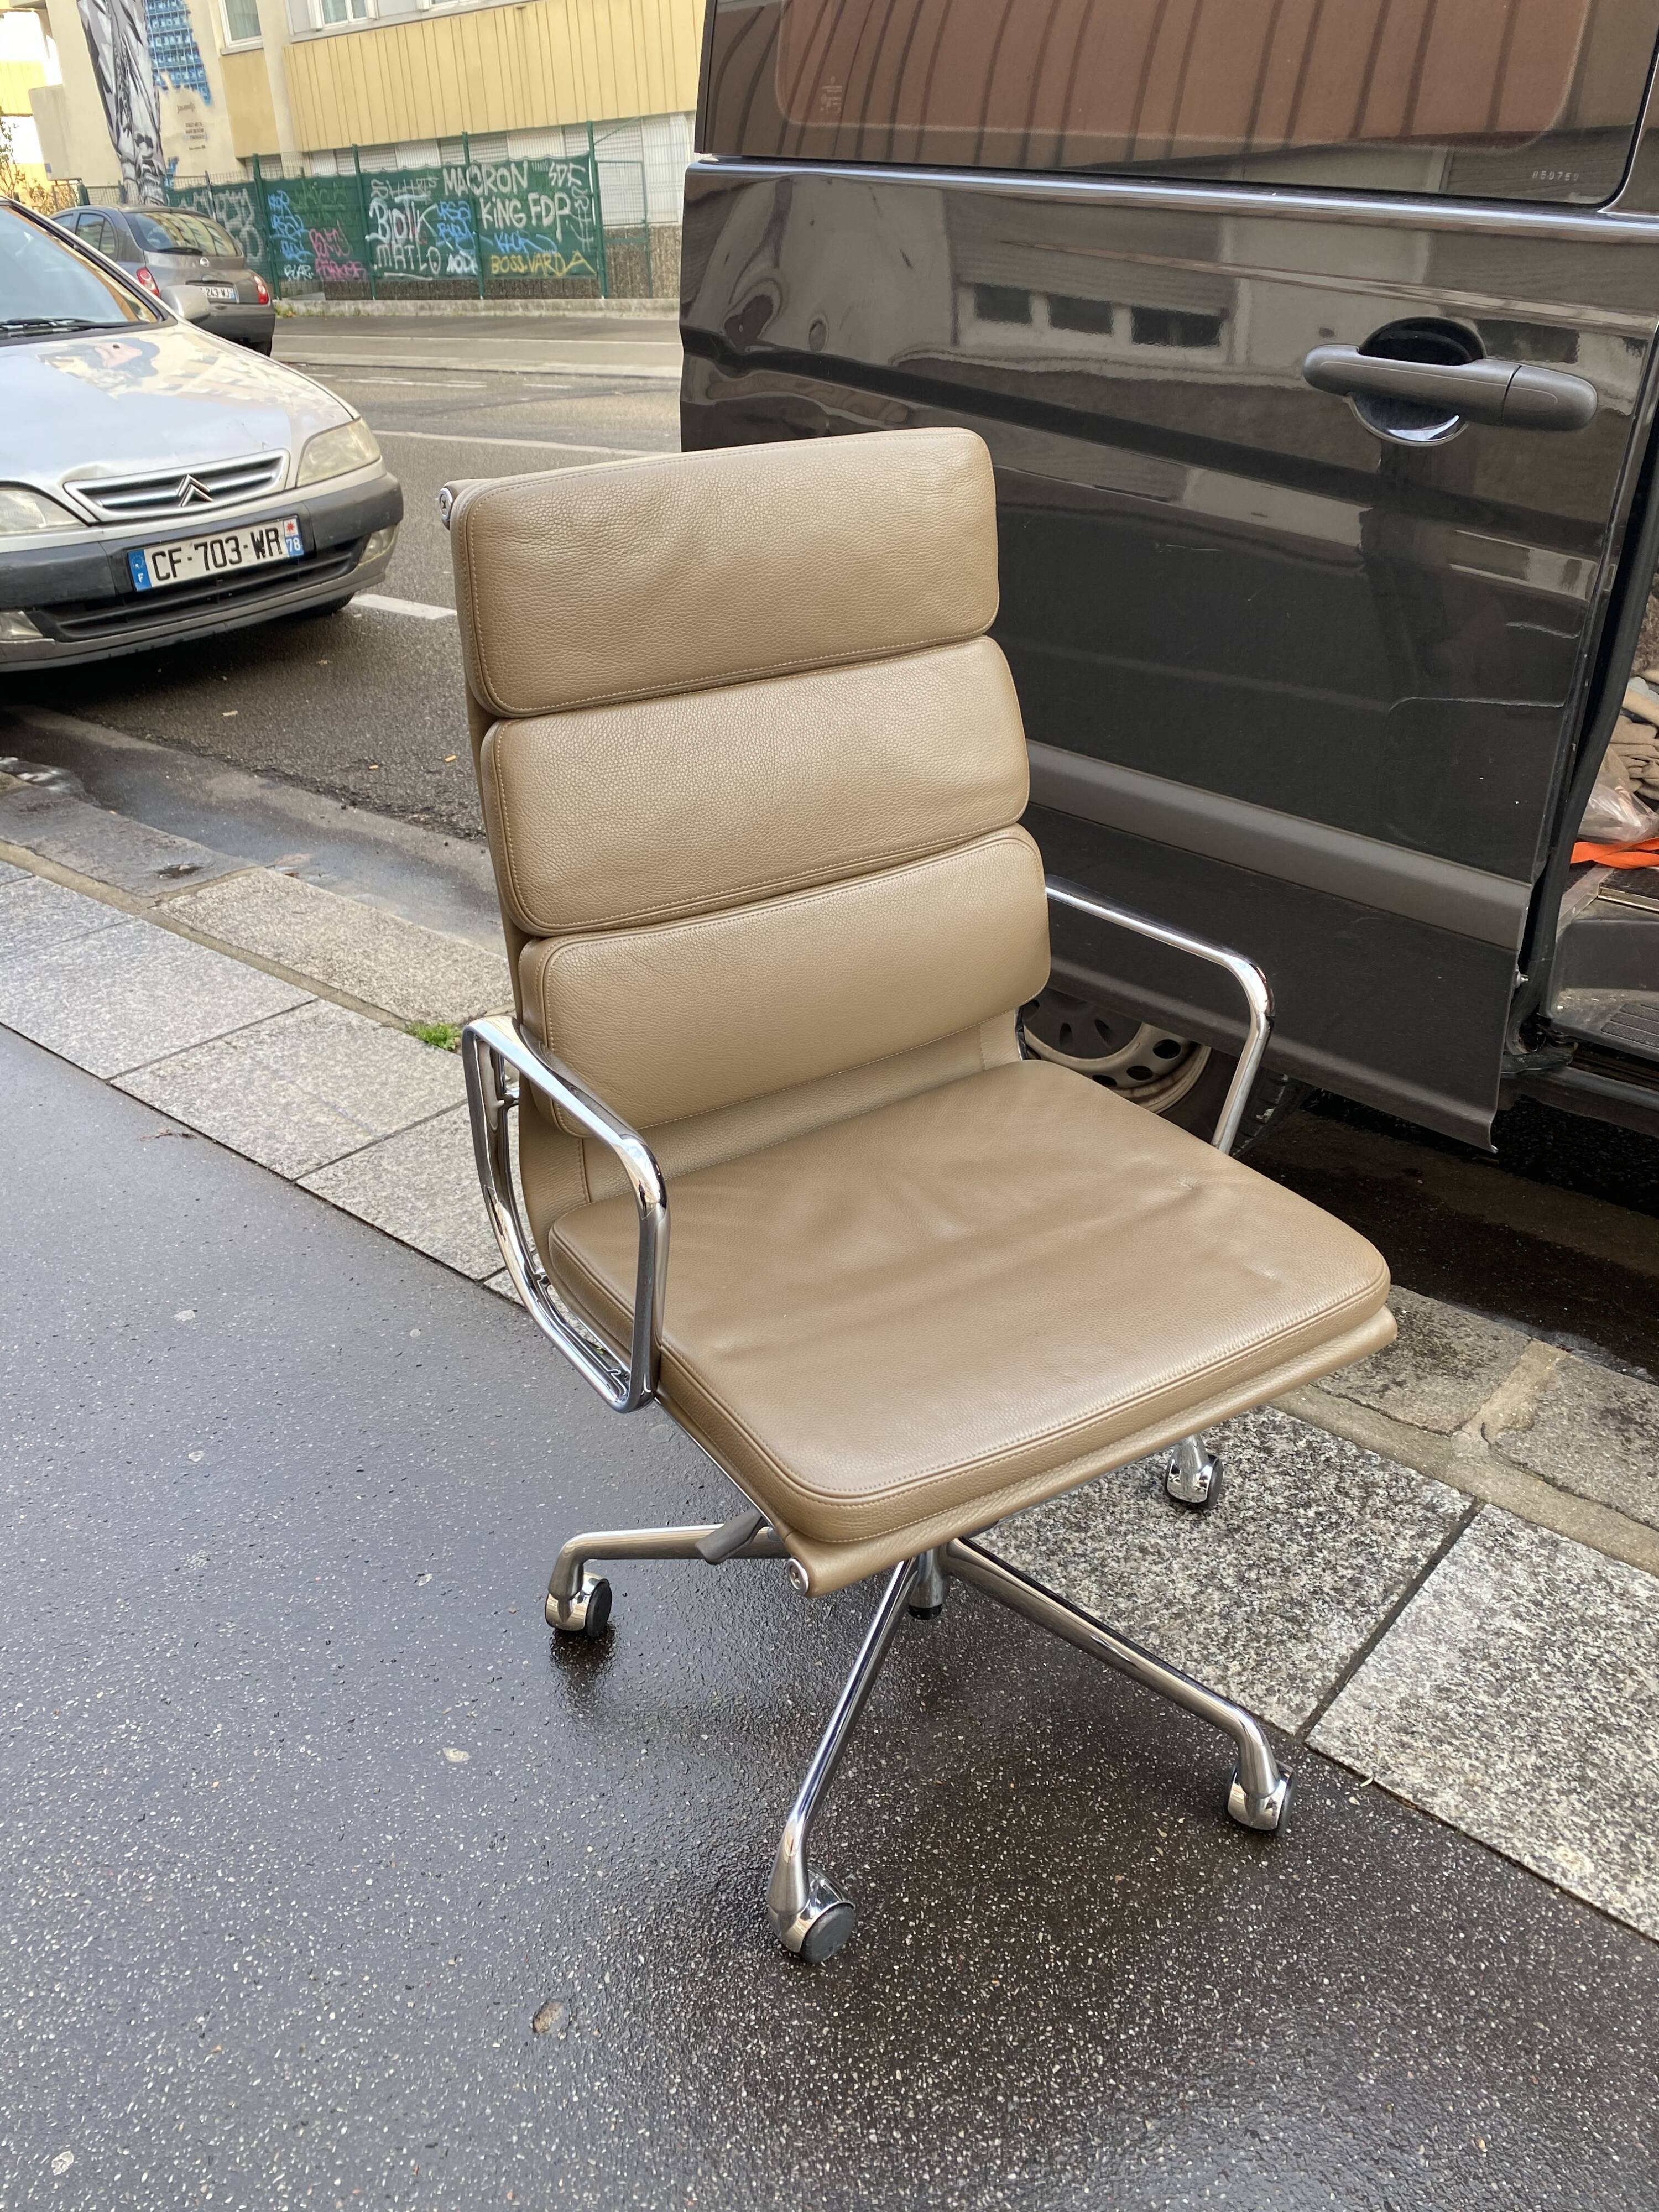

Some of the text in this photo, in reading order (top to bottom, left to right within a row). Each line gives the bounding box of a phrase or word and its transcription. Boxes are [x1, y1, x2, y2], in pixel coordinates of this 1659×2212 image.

[442, 161, 528, 196] MACRON
[206, 288, 218, 297] 243
[138, 527, 301, 583] F CF-703-WR 78
